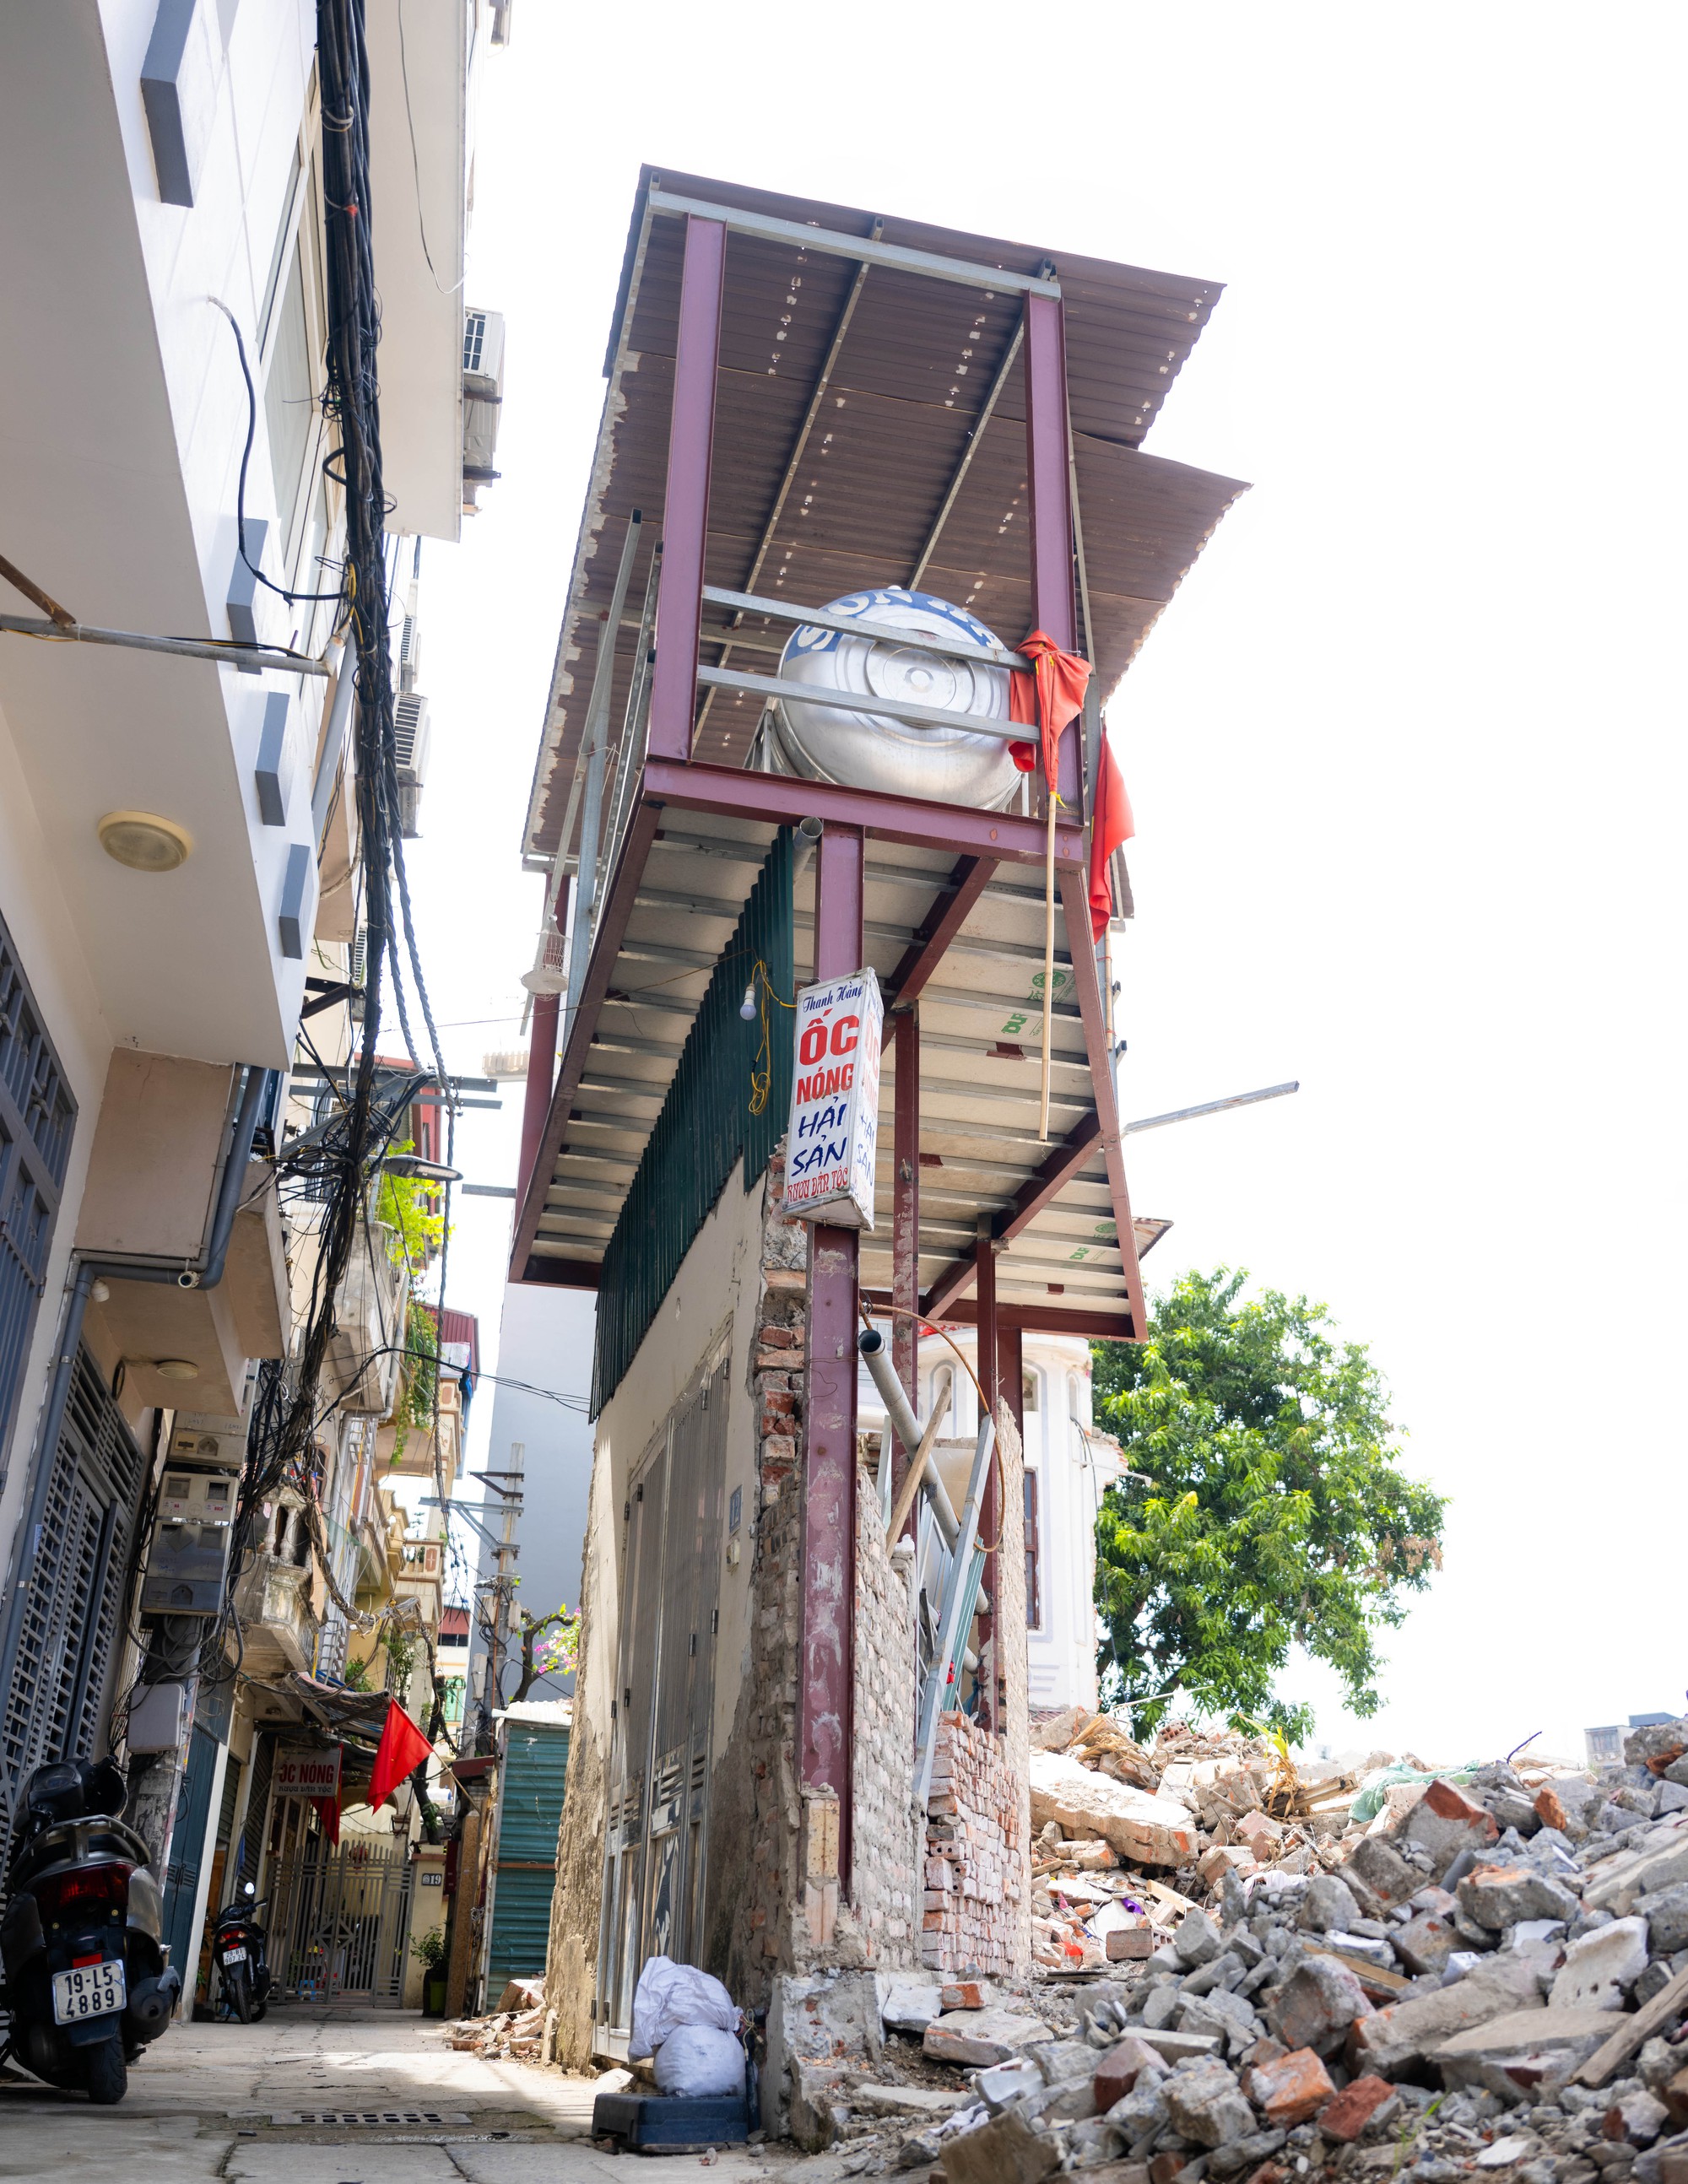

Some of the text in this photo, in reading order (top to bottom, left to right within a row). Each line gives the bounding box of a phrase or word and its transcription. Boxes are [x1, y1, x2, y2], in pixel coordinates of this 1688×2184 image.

[803, 981, 863, 1013] Thanh Hằng
[798, 1008, 860, 1066] ỐC
[797, 1063, 854, 1106] NÓNG
[798, 1095, 847, 1139] HẢI
[791, 1135, 848, 1177] SẢN
[299, 1760, 334, 1784] NÓNG
[430, 1874, 441, 1885] 19
[65, 1965, 114, 1995] 19-L5
[66, 1988, 115, 2018] 4889
